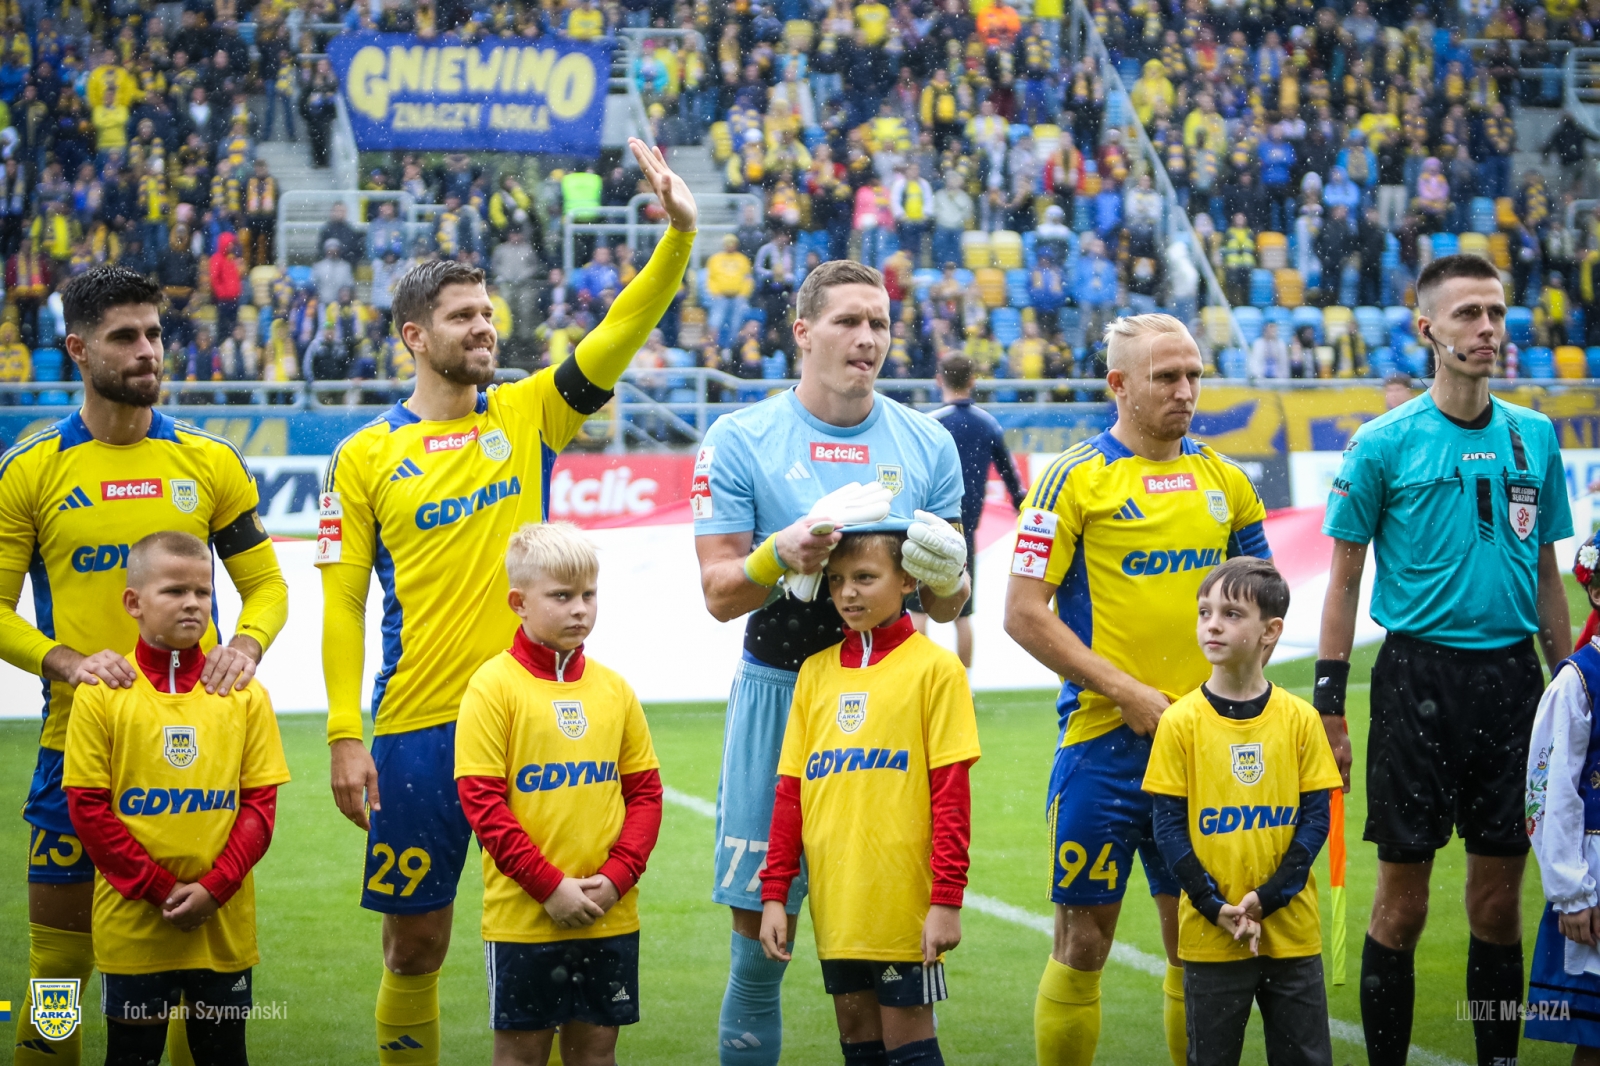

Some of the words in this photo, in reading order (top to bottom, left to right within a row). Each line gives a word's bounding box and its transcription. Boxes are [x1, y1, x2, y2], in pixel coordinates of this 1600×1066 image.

[347, 45, 595, 120] GNIEWINO
[392, 102, 481, 130] ZNACZY
[487, 103, 549, 132] ARKA
[428, 431, 476, 451] Betclic
[815, 446, 864, 460] Betclic
[106, 482, 158, 498] Betclic
[550, 466, 659, 516] tclic
[1148, 474, 1191, 491] Betclic
[414, 475, 522, 531] GDYNIA
[318, 524, 340, 535] etclic
[1024, 525, 1051, 534] SUZUKI
[71, 543, 131, 574] GDY
[1017, 539, 1049, 553] Betclic
[1121, 548, 1223, 577] GDYNIA
[805, 747, 909, 781] GDYNIA
[118, 787, 236, 816] GDYNIA
[367, 842, 432, 897] 29
[720, 835, 769, 892] 77
[1057, 840, 1119, 890] 94
